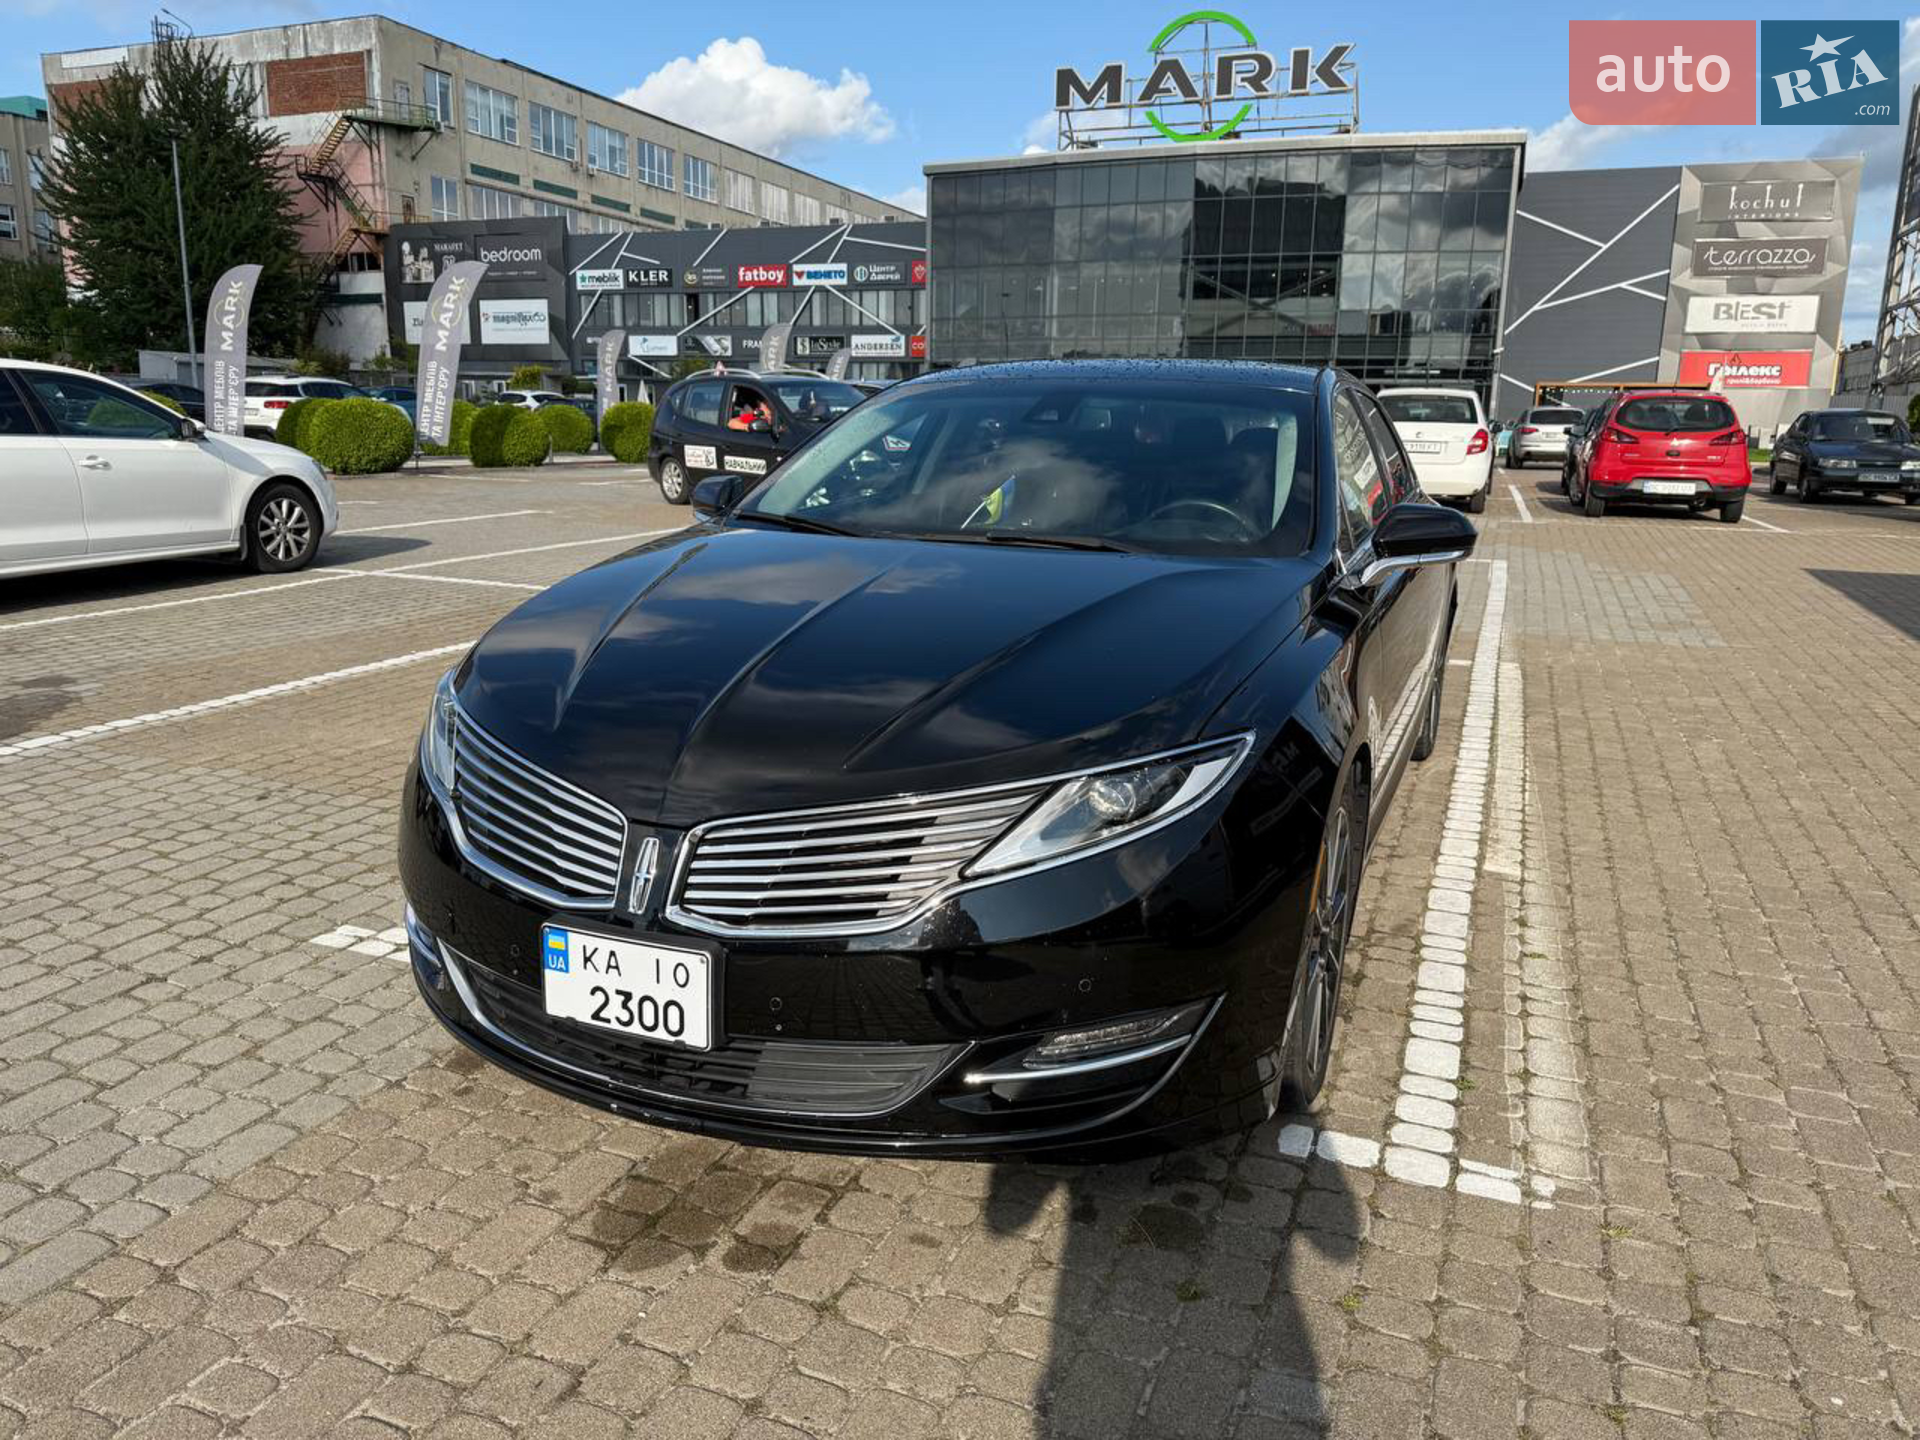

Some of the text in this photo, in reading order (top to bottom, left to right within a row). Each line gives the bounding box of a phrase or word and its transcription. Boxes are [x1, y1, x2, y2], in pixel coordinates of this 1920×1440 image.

[1055, 43, 1357, 111] MARK
[481, 246, 542, 263] bedroom
[1703, 245, 1816, 265] terrazzo
[588, 272, 620, 284] meblik
[629, 270, 669, 282] KLER
[738, 266, 784, 283] fatboy
[220, 280, 243, 351] MARK
[435, 275, 465, 352] MARK
[854, 342, 902, 351] ANDERSEN
[549, 953, 566, 971] UA
[582, 945, 622, 977] KA
[589, 985, 685, 1038] 2300
